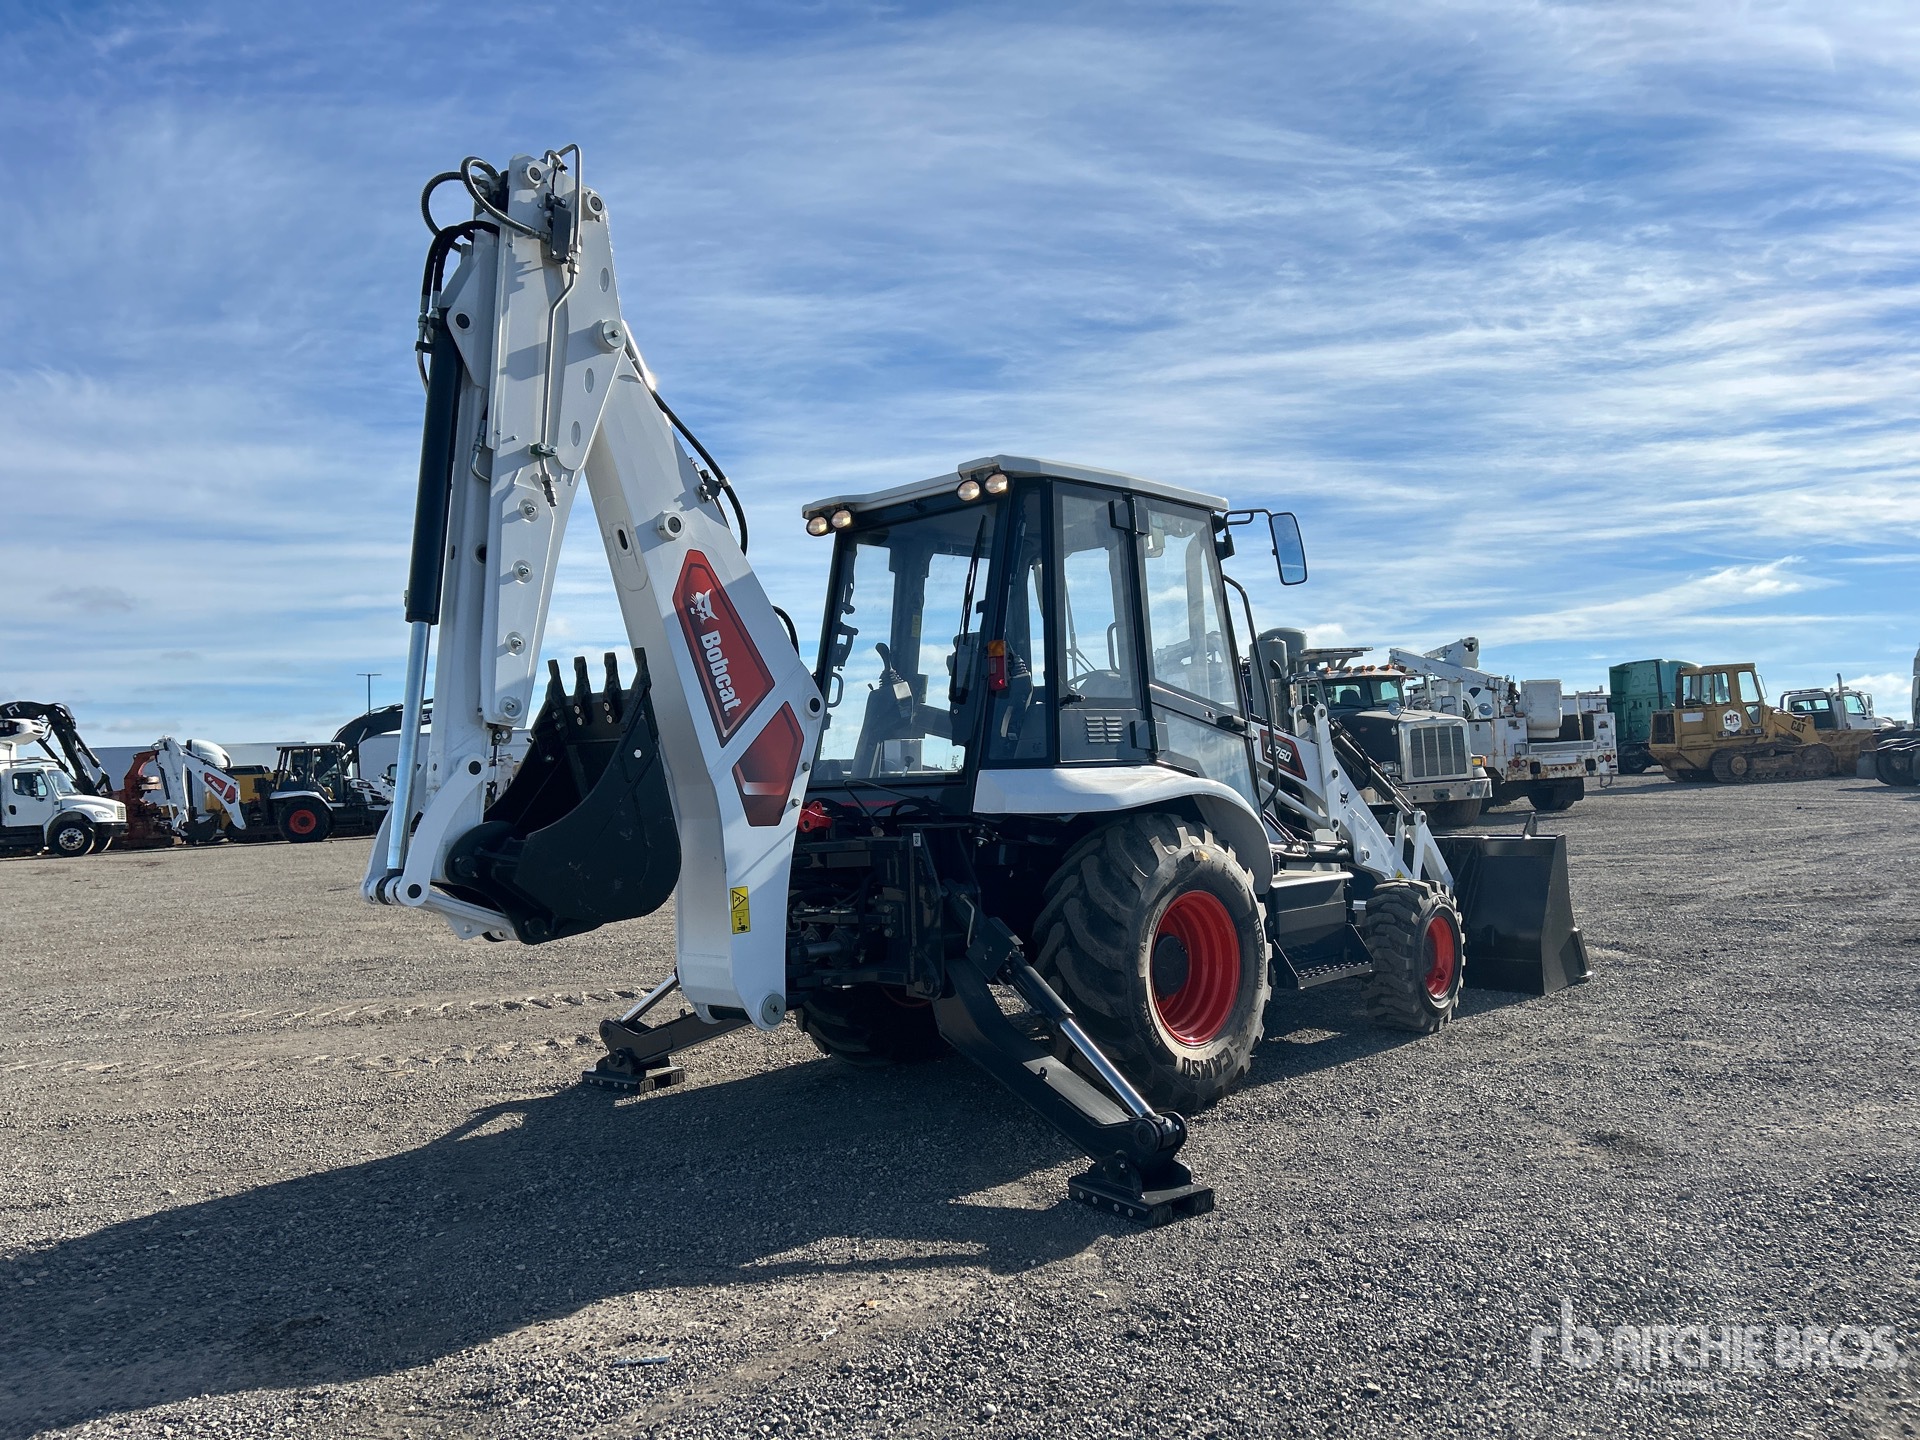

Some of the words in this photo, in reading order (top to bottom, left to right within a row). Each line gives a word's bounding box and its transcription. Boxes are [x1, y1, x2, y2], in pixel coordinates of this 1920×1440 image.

[700, 630, 742, 712] Bobcat
[1791, 720, 1807, 733] CAT
[1181, 1047, 1234, 1078] CAMSO
